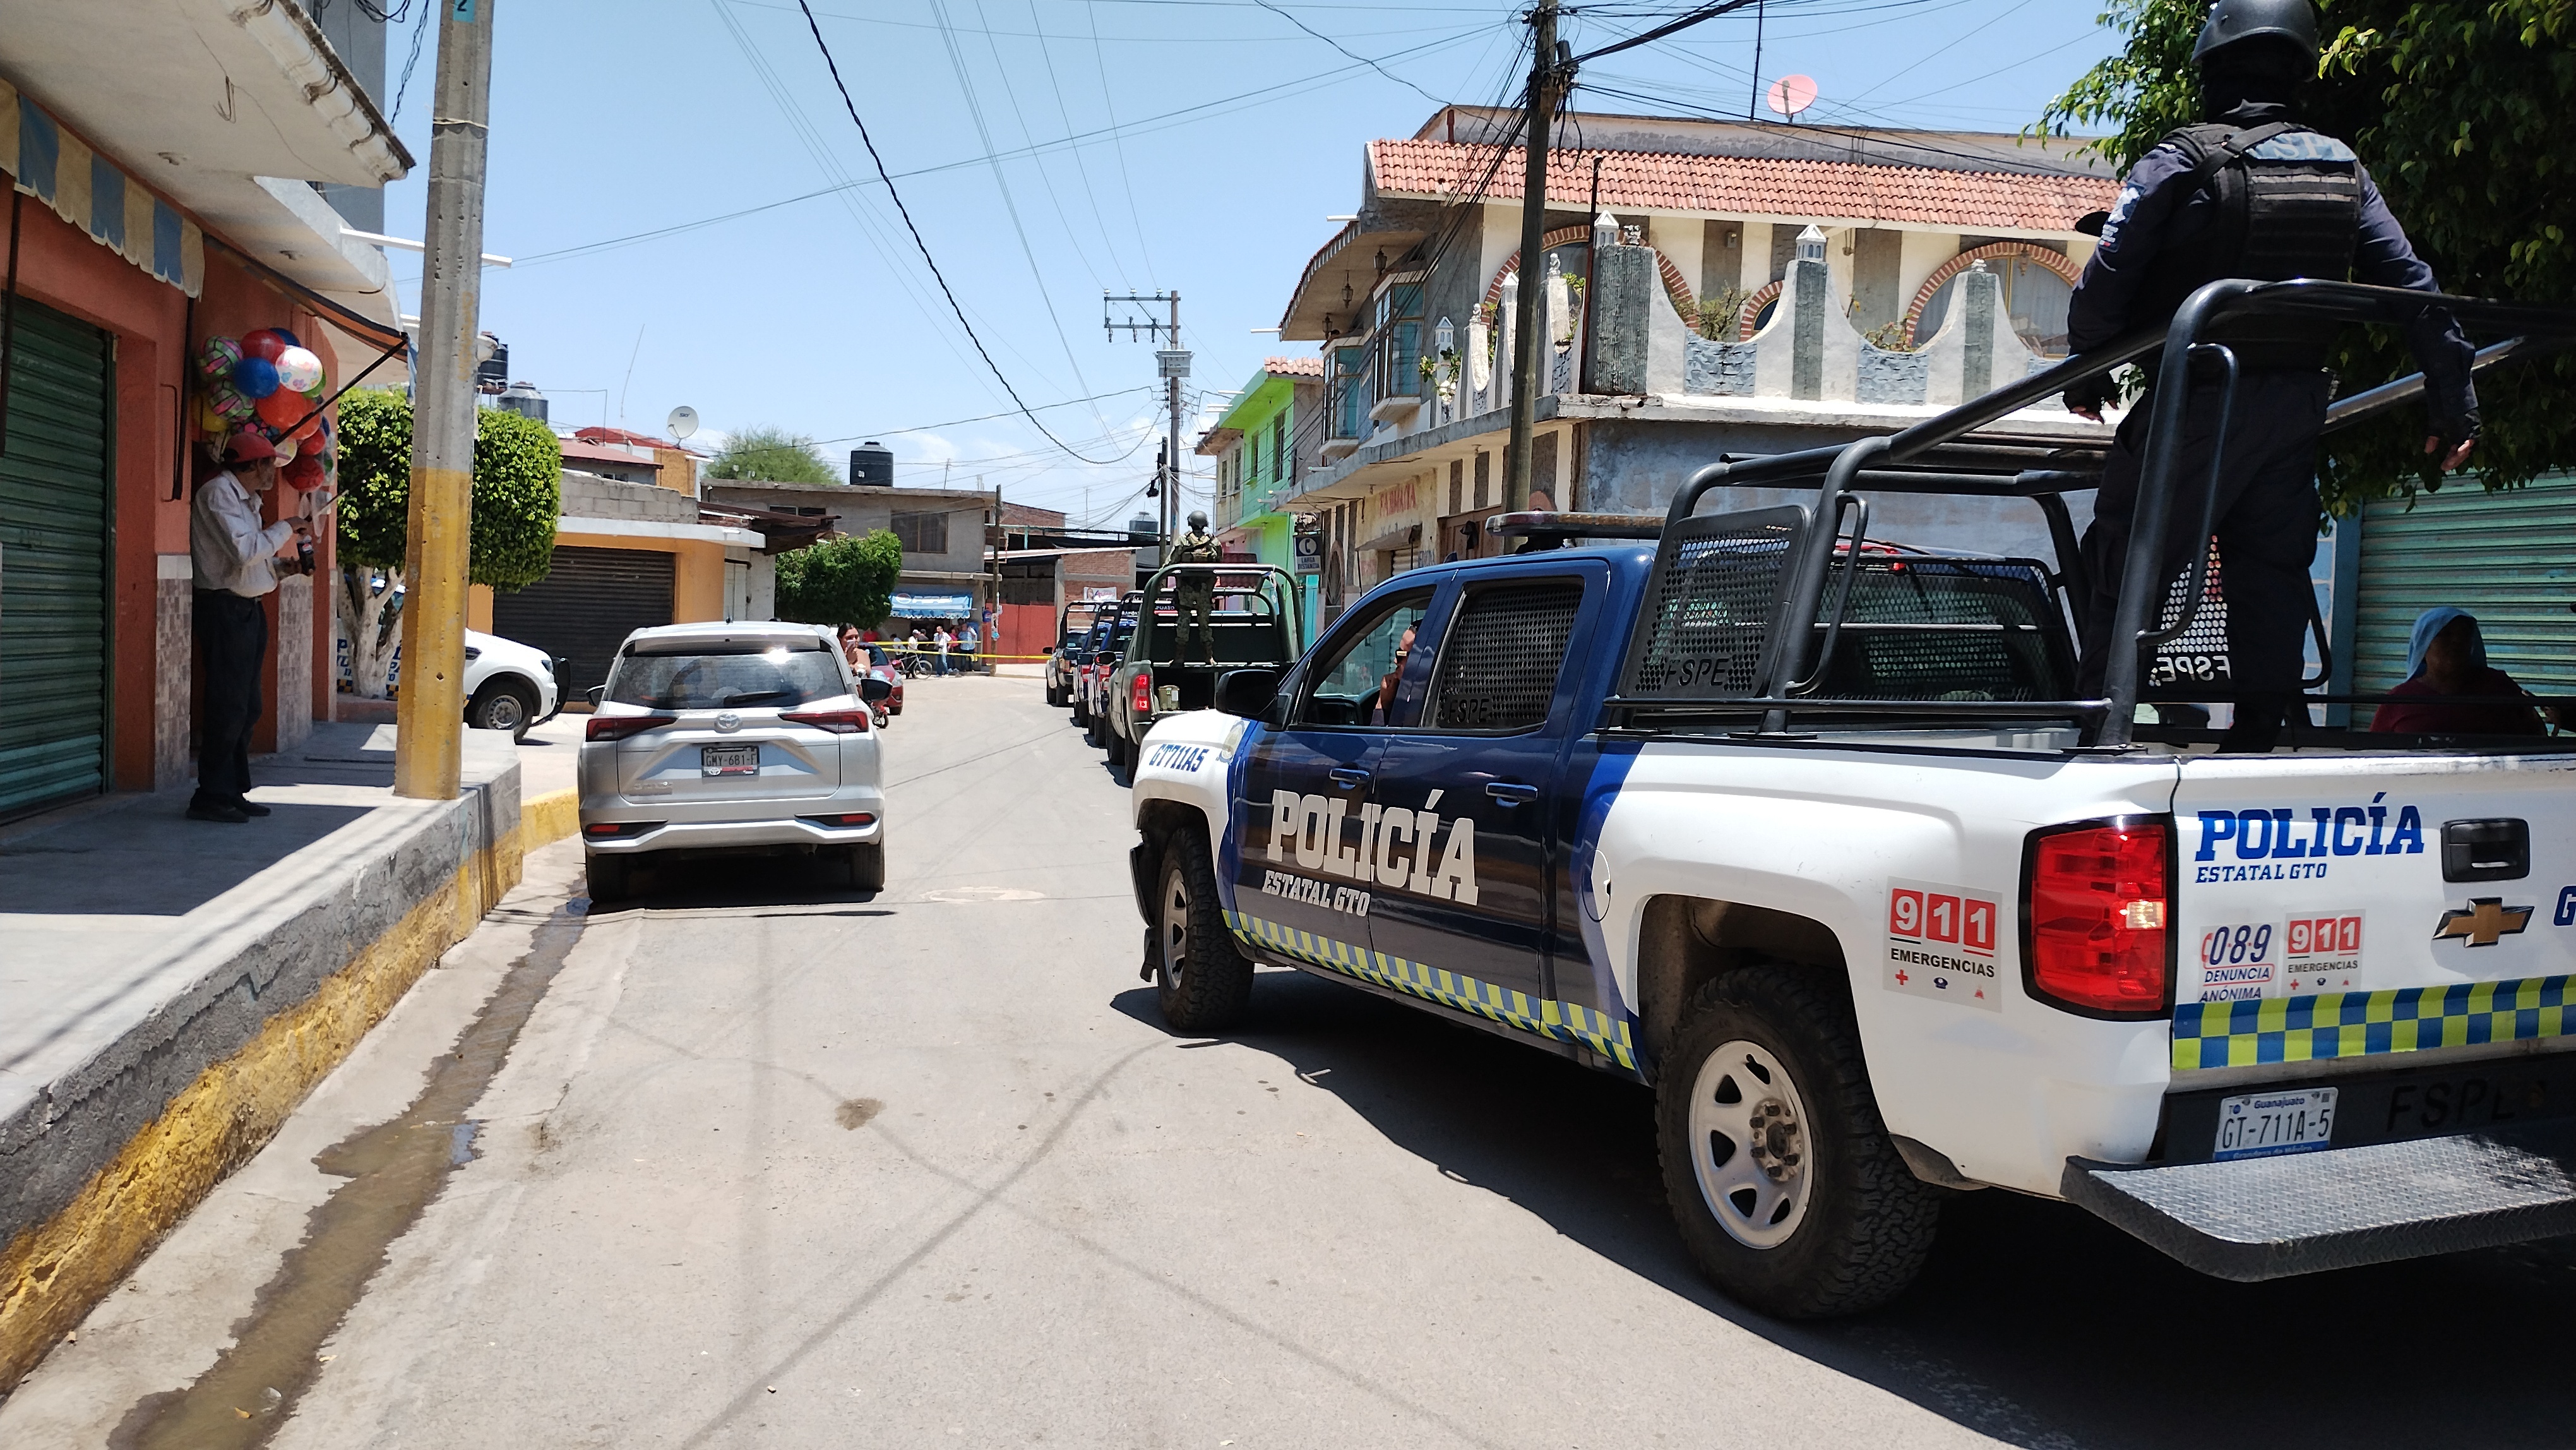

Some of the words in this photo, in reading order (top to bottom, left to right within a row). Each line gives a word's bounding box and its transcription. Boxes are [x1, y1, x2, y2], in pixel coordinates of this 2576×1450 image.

[1664, 659, 1729, 686] FSPE
[1448, 698, 1490, 723] FSPE
[1148, 743, 1210, 772] GT711A5
[2194, 791, 2425, 862] POLICÍA
[1267, 789, 1479, 906] POLICÍA
[2195, 864, 2285, 883] ESTATAL
[2289, 863, 2327, 879] GTO
[1261, 869, 1331, 908] ESTATAL
[1333, 886, 1371, 917] GTO
[1895, 896, 1987, 944] 911
[2291, 921, 2355, 950] 911
[1890, 947, 1995, 978] EMERGENCIAS
[2204, 967, 2270, 983] DENUNCIA
[2287, 960, 2358, 973] EMERGENCIAS
[2199, 985, 2262, 1003] ANÓNIMA
[2254, 1097, 2305, 1108] Guanajuato
[2222, 1108, 2331, 1149] GT-711A-5
